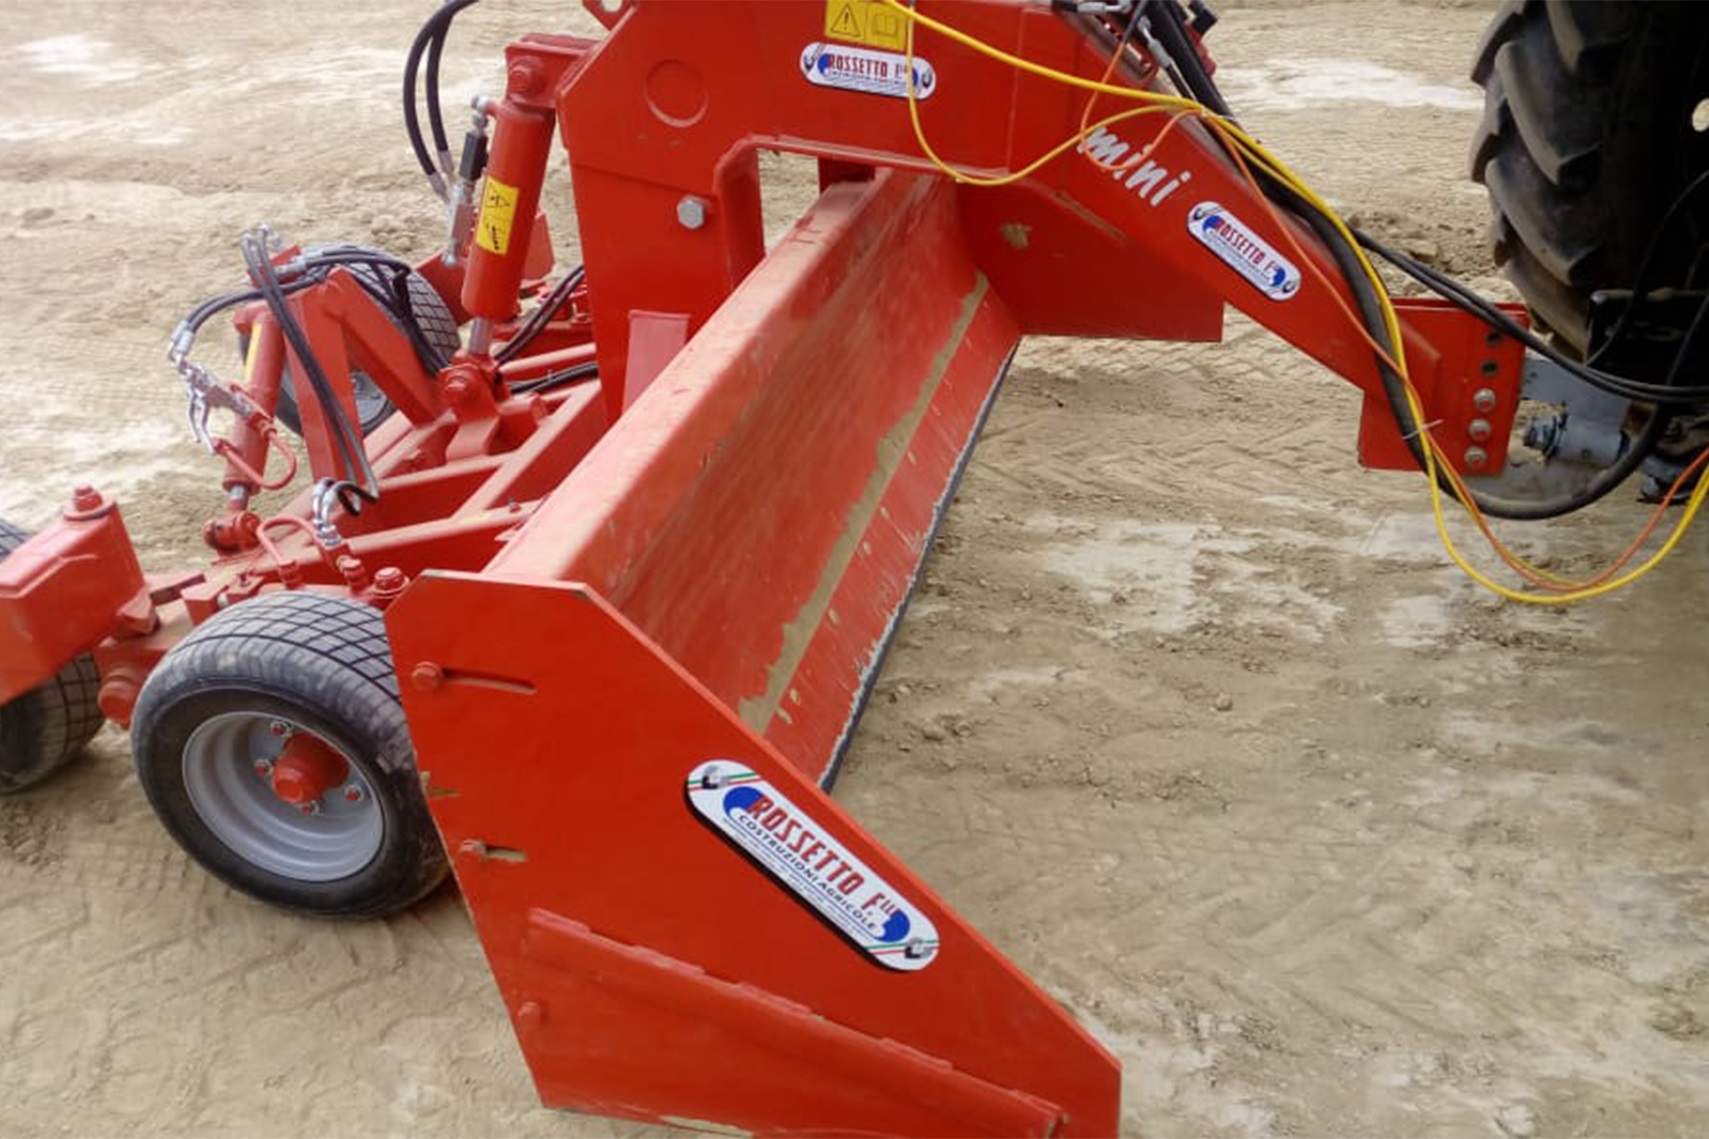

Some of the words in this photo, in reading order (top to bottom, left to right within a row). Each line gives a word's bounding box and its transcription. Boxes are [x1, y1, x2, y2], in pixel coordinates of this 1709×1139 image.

[828, 53, 888, 78] ROSSETTO
[1076, 125, 1192, 207] mini
[1212, 217, 1266, 265] ROSSETTO
[738, 814, 820, 884] COSTRUZIONI
[818, 880, 877, 931] AGRICOLE
[746, 793, 865, 896] ROSSETTO
